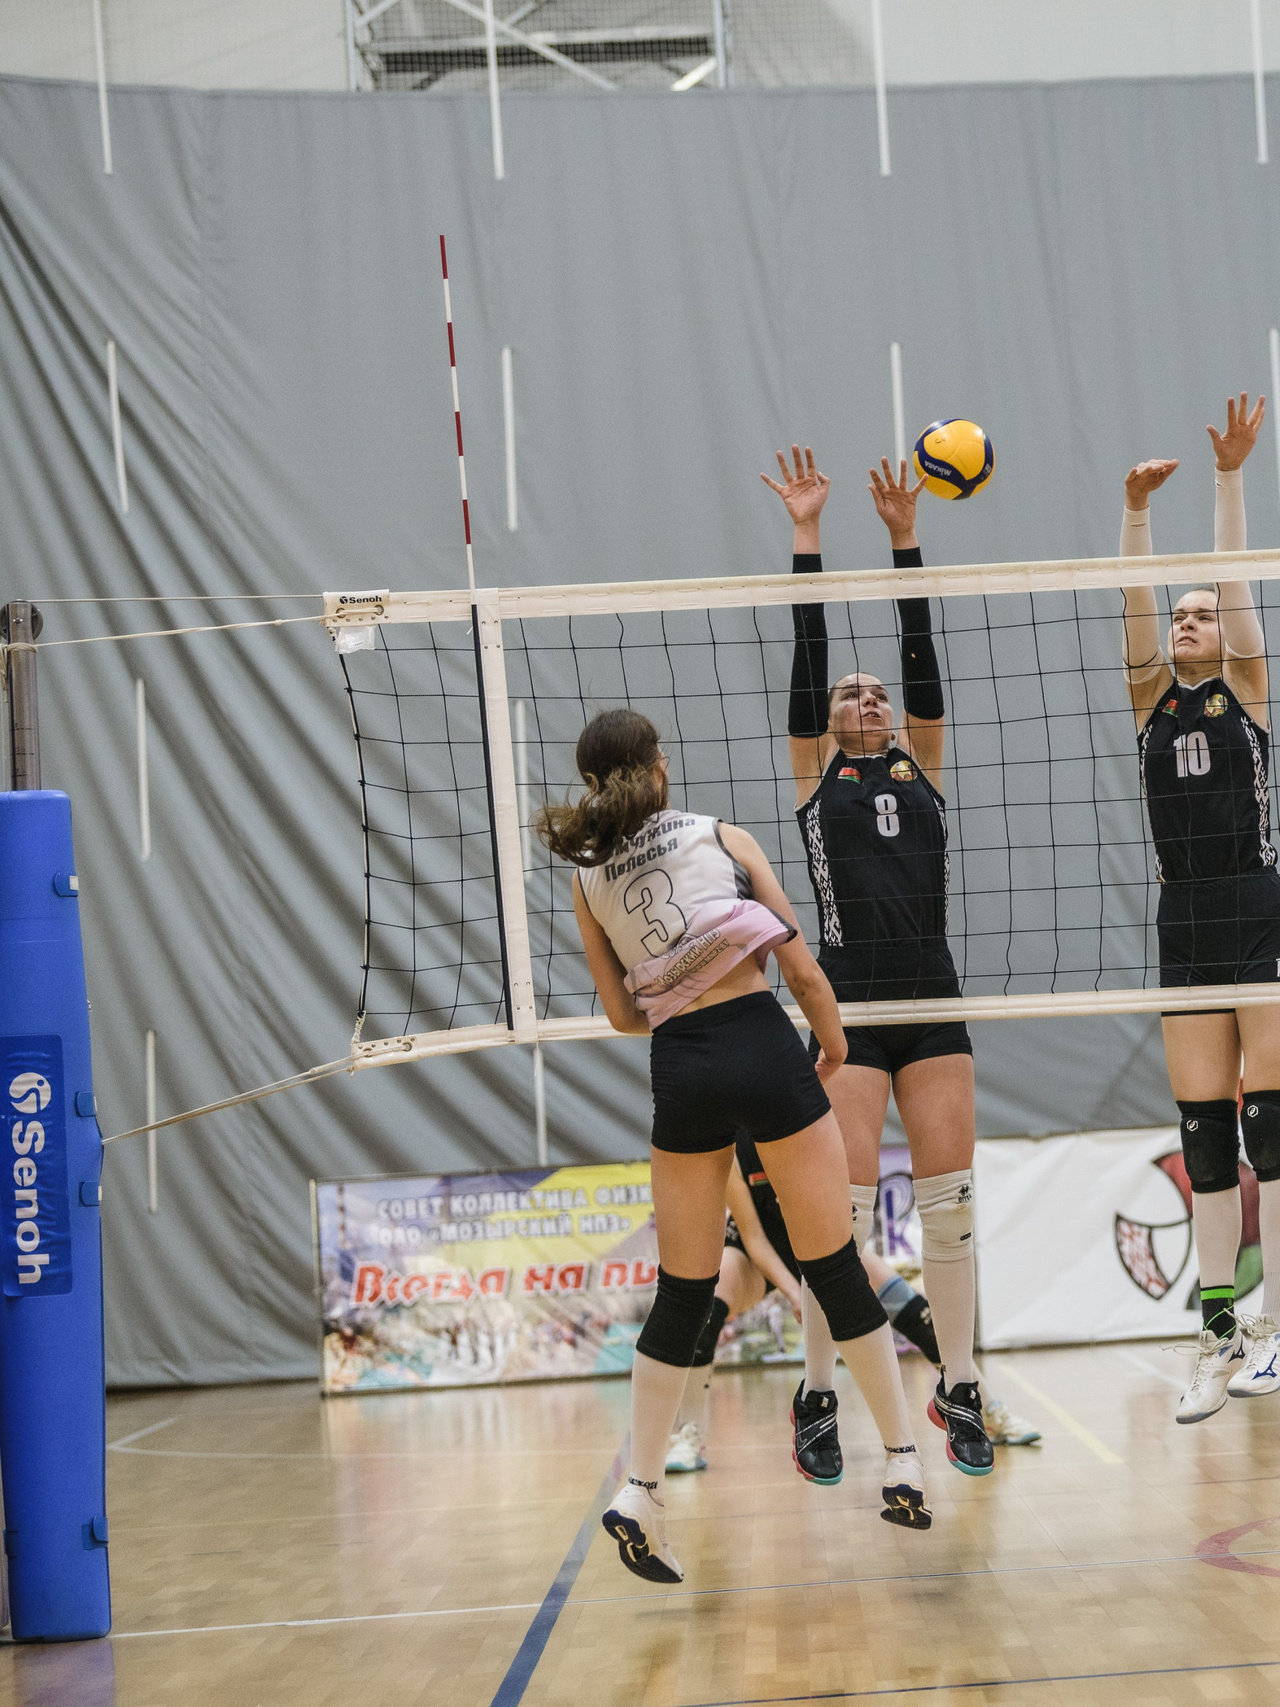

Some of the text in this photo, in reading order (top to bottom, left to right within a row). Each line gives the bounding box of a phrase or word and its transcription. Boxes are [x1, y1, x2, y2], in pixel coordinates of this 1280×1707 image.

[349, 595, 382, 604] Senoh
[1173, 731, 1211, 778] 10
[615, 818, 695, 856] мчужина
[874, 793, 900, 838] 8
[605, 837, 678, 882] Полесья
[623, 868, 687, 958] 3
[12, 1120, 50, 1284] Senoh
[378, 1196, 444, 1219] СОВЕТ
[450, 1187, 588, 1215] КОЛЛЕКТИВА
[377, 1225, 421, 1246] ОАО
[353, 1262, 509, 1304] Всегда
[522, 1261, 588, 1295] на
